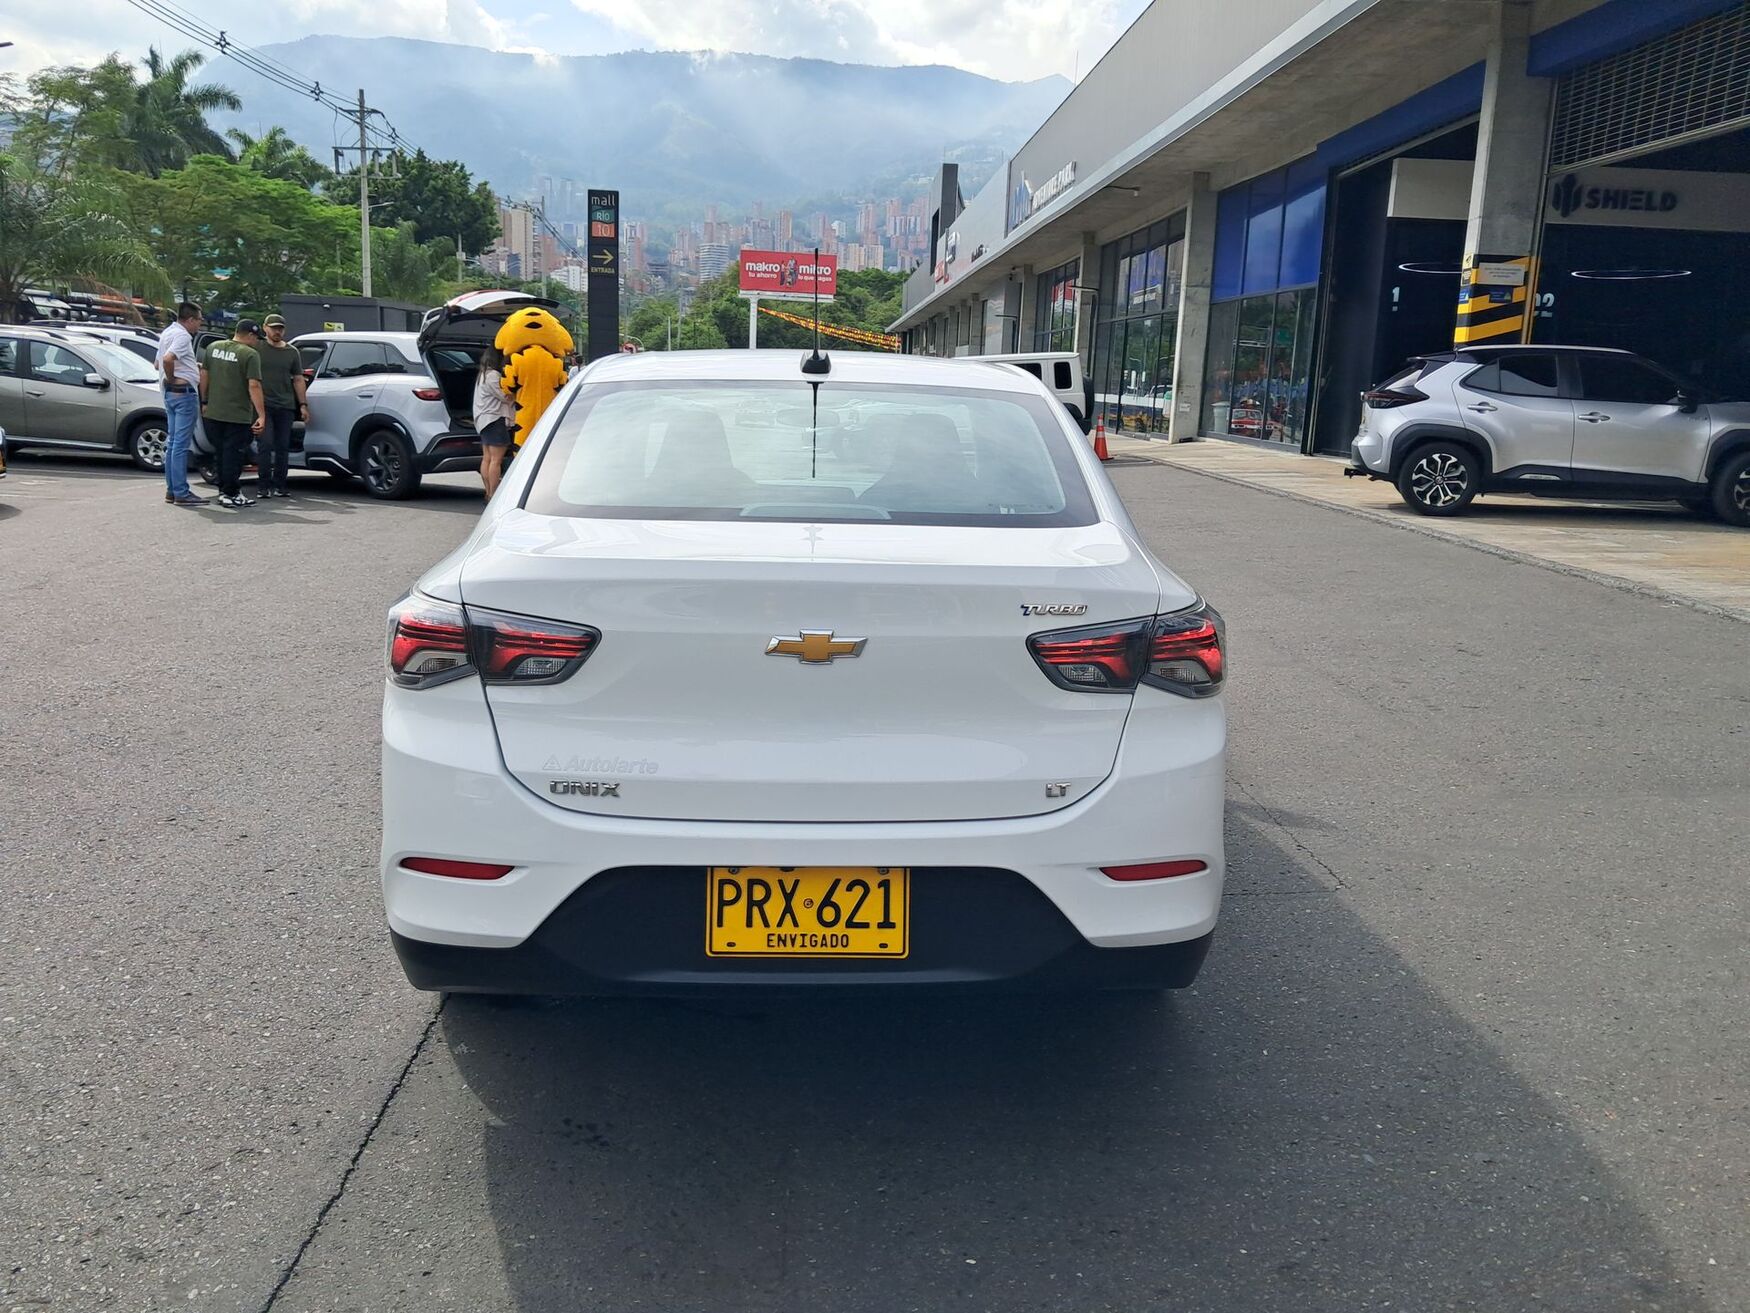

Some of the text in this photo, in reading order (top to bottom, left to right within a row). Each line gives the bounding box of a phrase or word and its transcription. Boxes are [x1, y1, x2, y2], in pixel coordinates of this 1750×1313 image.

[591, 195, 616, 206] mall
[1585, 188, 1678, 211] SHIELD
[745, 261, 780, 272] makro
[756, 271, 777, 279] ahorro
[1020, 604, 1088, 617] TURBO
[565, 756, 659, 775] Autolarte
[549, 780, 621, 798] ONIX
[1046, 782, 1071, 798] LT
[716, 878, 896, 929] PRX 621
[766, 932, 849, 948] ENVIGADO
